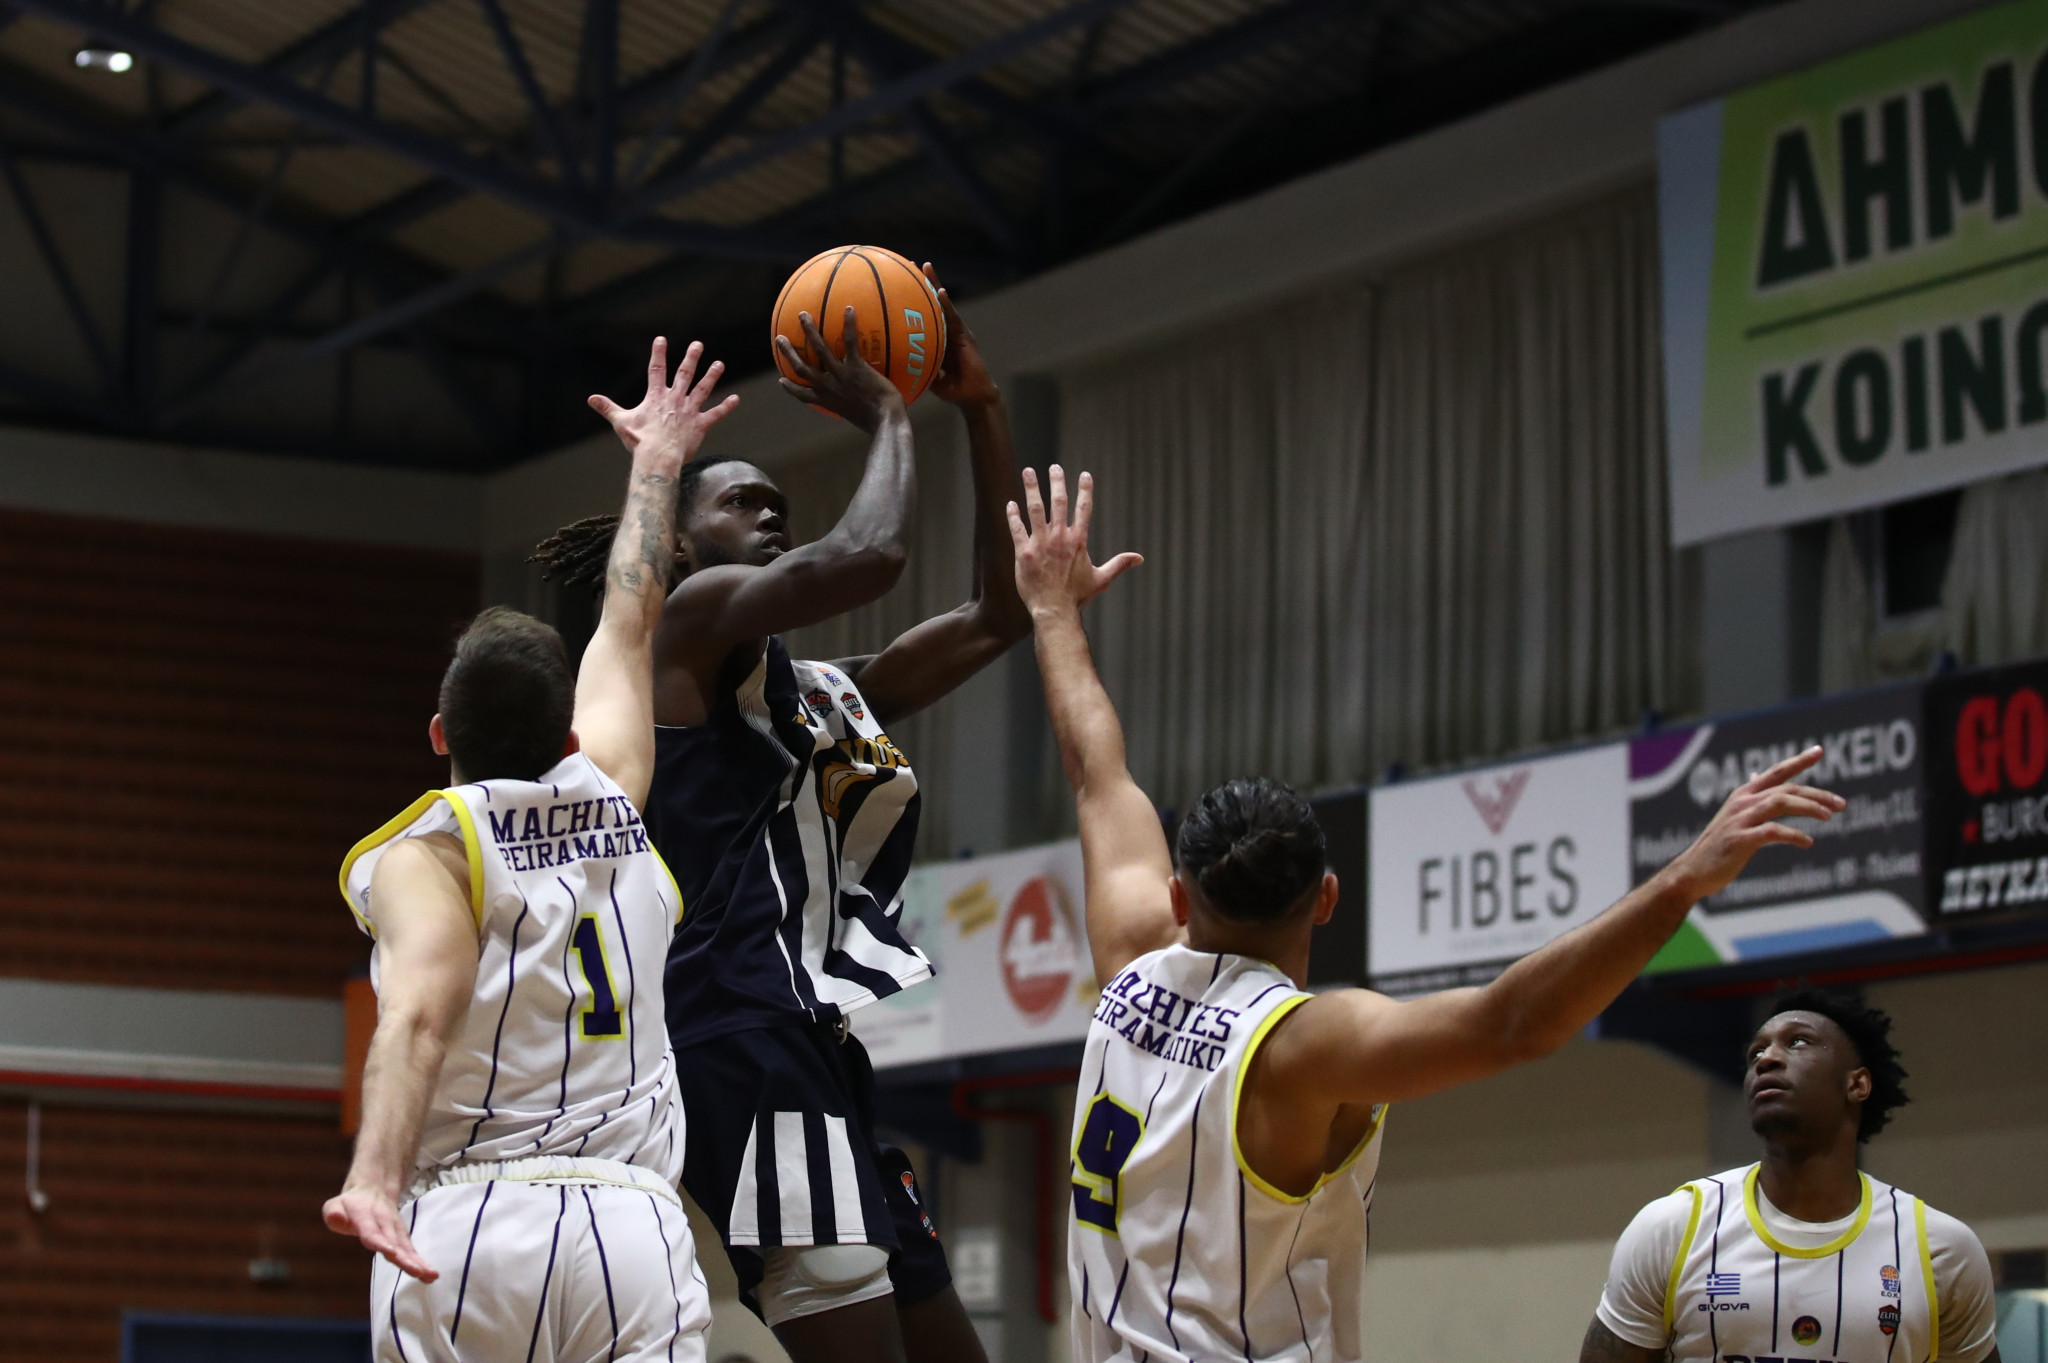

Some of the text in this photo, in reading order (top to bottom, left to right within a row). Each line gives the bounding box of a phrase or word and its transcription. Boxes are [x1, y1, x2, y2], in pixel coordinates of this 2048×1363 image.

[1418, 835, 1580, 936] FIBES
[570, 912, 626, 1041] 1
[1106, 966, 1241, 1042] ACHIES
[1071, 1090, 1145, 1239] 9
[1698, 1303, 1750, 1312] GIVOVA
[1880, 1311, 1899, 1321] ELITE
